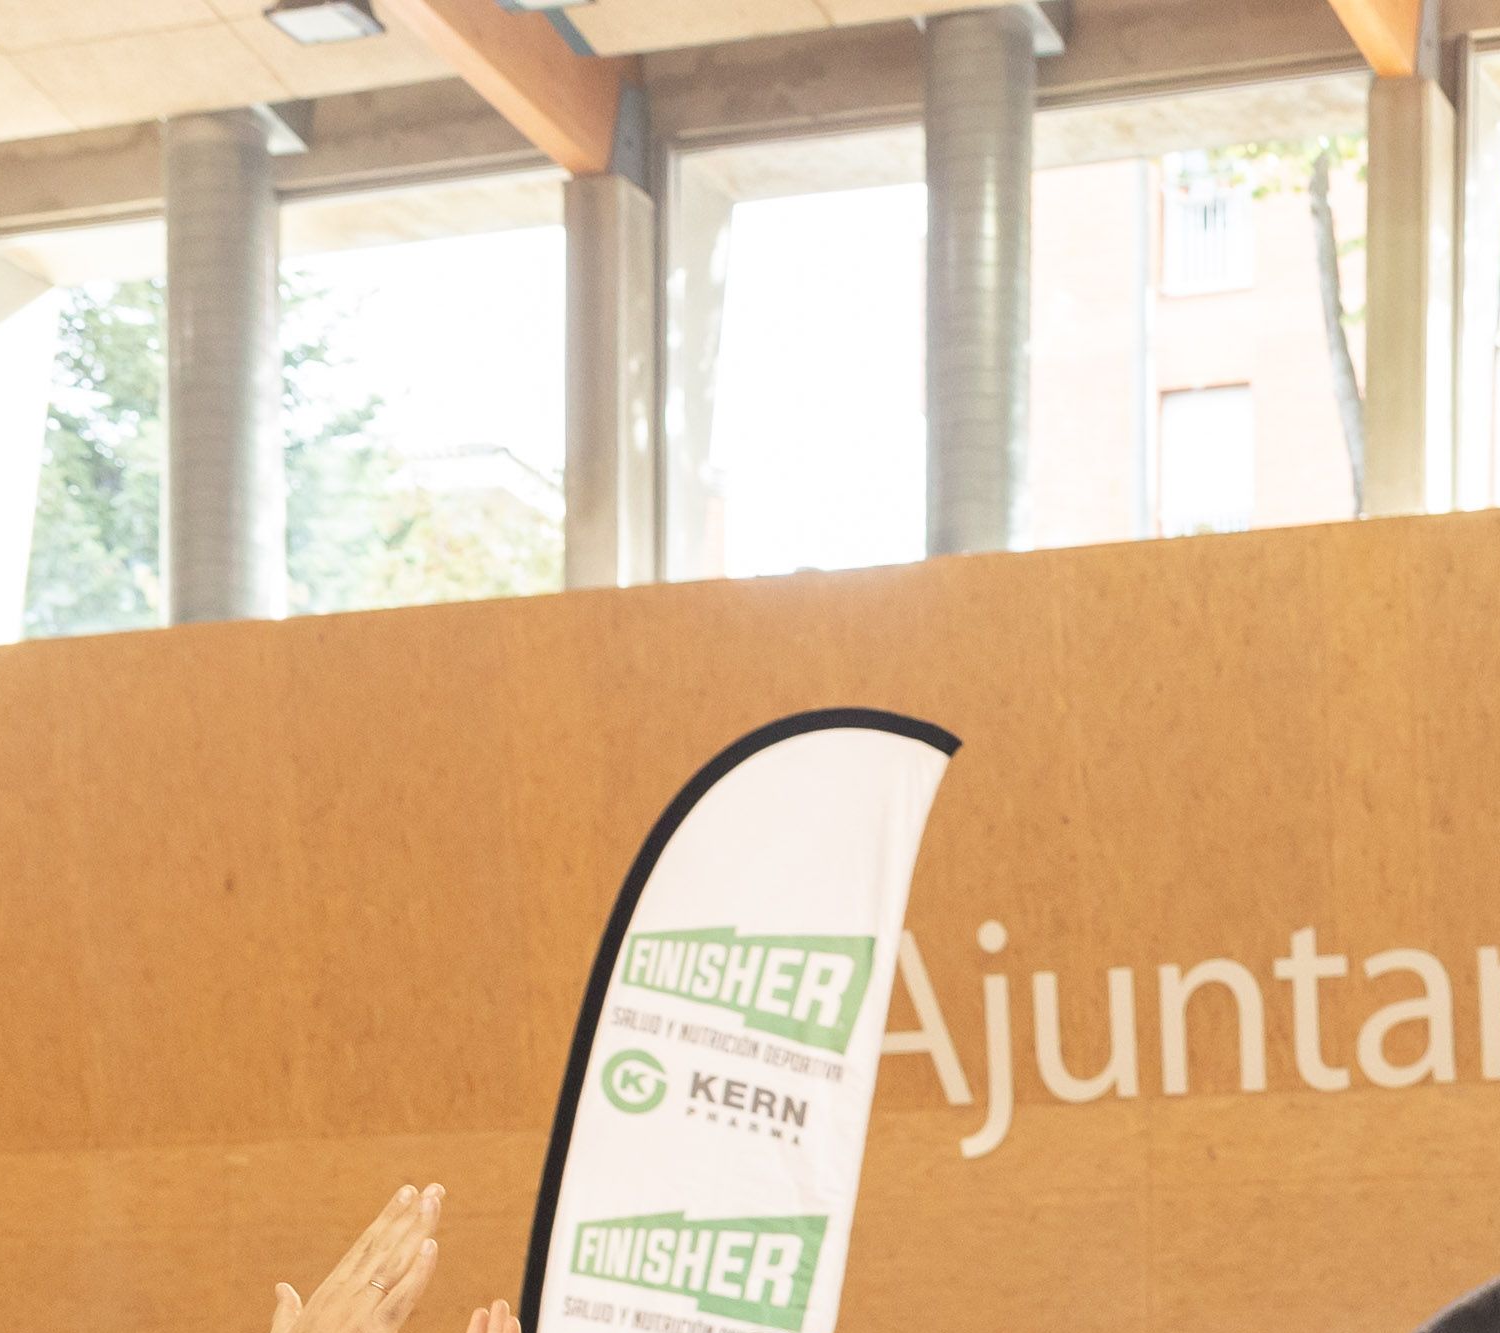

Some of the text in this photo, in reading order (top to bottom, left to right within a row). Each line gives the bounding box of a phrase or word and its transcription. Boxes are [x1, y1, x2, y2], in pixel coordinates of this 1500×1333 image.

[627, 938, 856, 1029] FINISHER
[609, 1005, 663, 1037] SALUD
[688, 1070, 809, 1129] KERN
[576, 1227, 805, 1308] FINISHER
